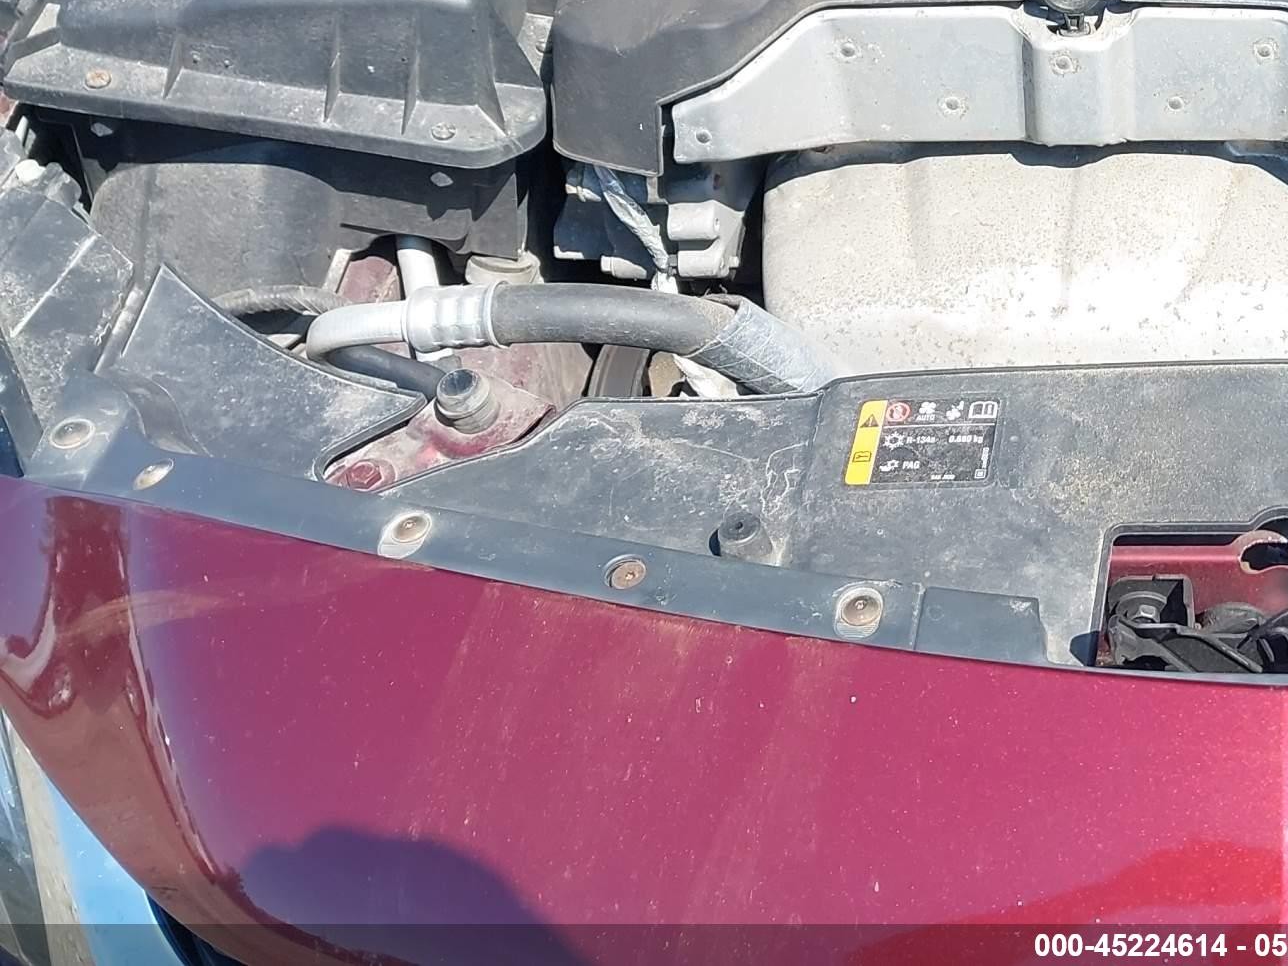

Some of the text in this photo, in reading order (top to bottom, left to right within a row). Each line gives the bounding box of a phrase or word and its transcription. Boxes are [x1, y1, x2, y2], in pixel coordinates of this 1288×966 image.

[906, 435, 936, 444] R-134a
[972, 434, 984, 444] kg
[902, 460, 921, 470] PAG
